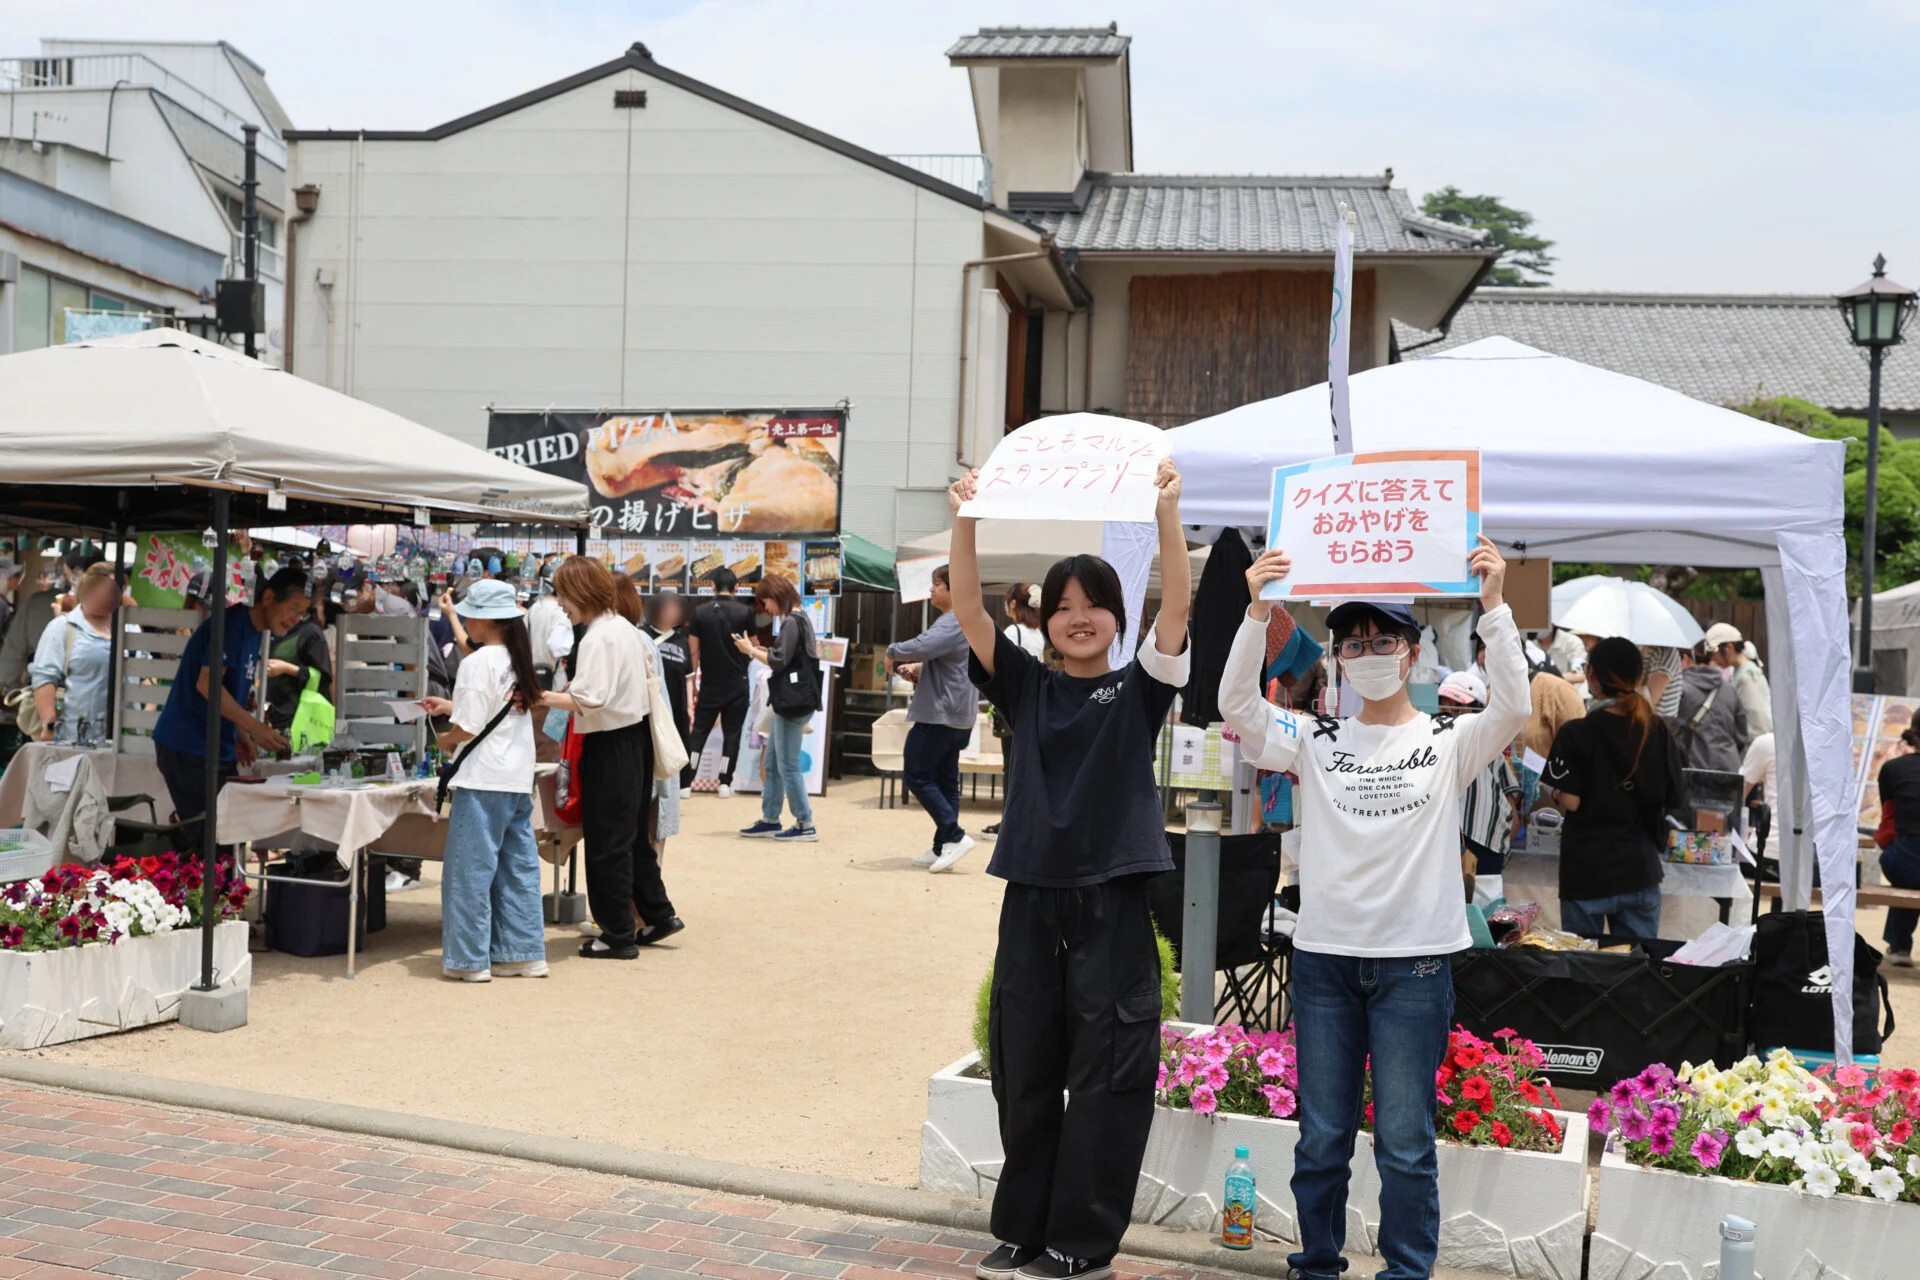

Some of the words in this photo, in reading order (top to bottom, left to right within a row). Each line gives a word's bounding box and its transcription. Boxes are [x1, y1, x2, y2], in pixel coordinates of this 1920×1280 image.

[587, 412, 679, 452] PIZZA
[1292, 477, 1455, 510] クイズに答えて
[1312, 507, 1430, 536] おみやげを
[1327, 538, 1415, 565] もらおう
[1359, 791, 1401, 800] LOVETOXIC
[1393, 782, 1415, 790] SPOIL
[1352, 807, 1387, 817] TREAT
[1391, 793, 1432, 816] MYSELF
[1800, 985, 1833, 994] LOTT
[1541, 1048, 1586, 1066] leman
